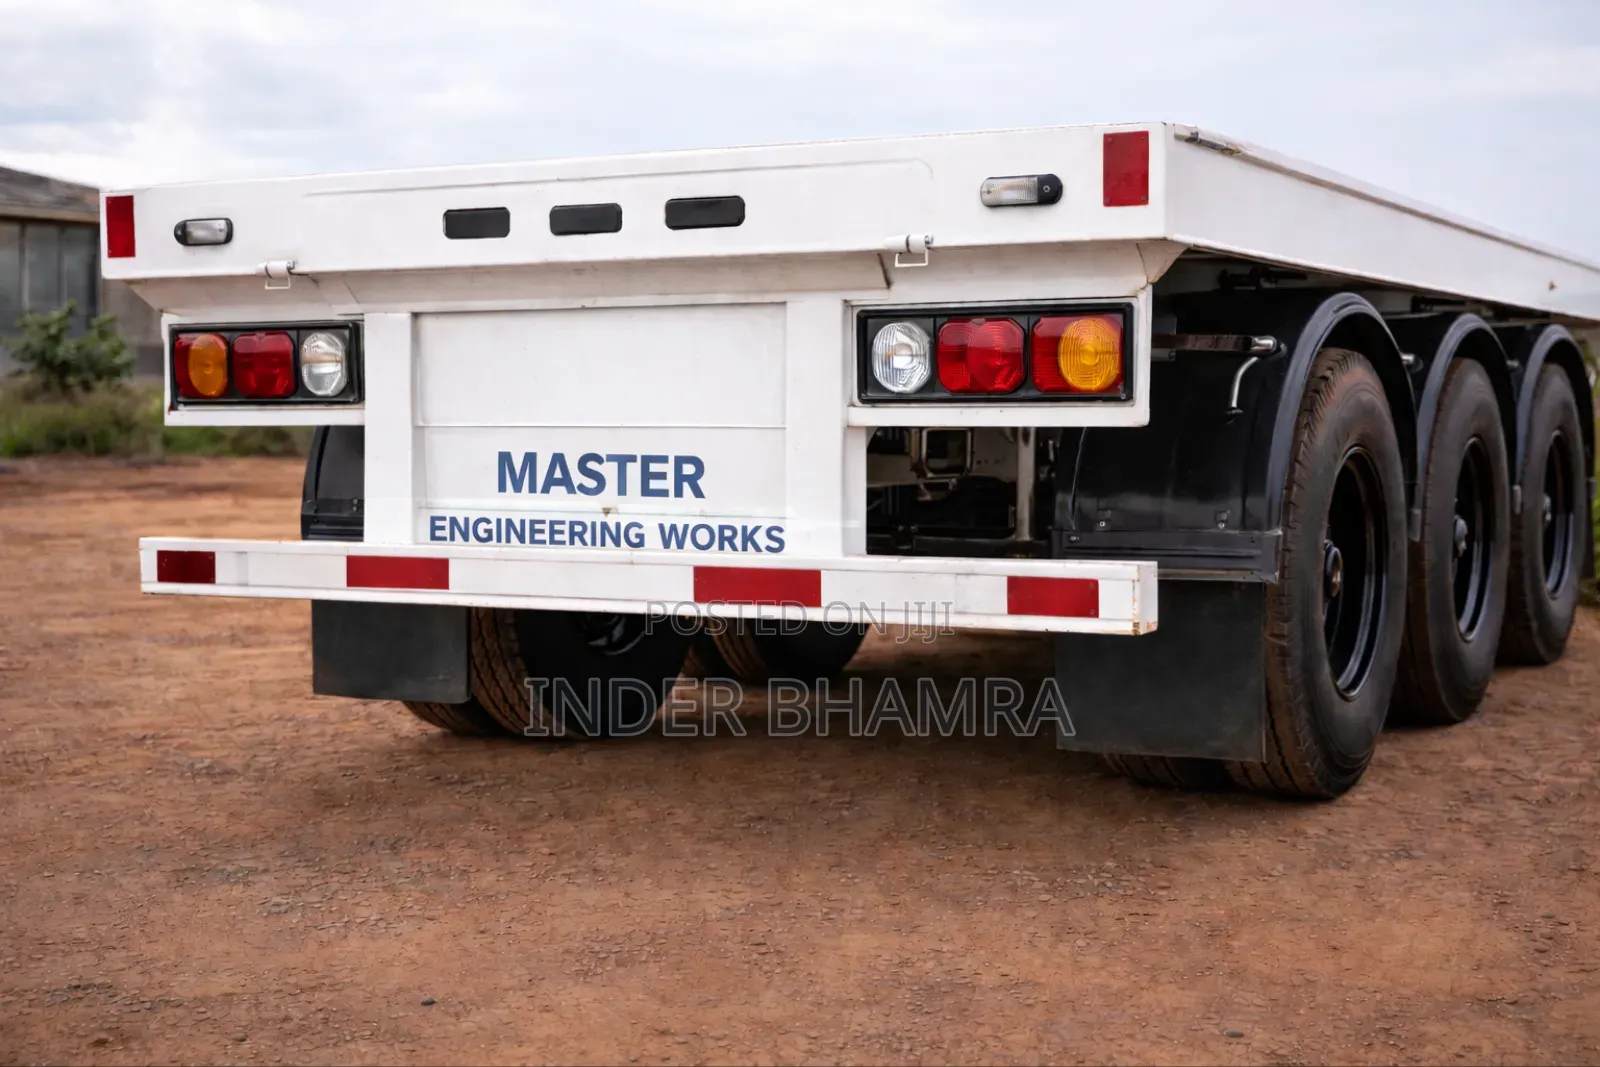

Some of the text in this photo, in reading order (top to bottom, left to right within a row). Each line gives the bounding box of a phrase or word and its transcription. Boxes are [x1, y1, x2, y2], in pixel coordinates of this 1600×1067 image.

[498, 451, 706, 499] MASTER
[429, 515, 786, 553] ENGINEERING WORKS
